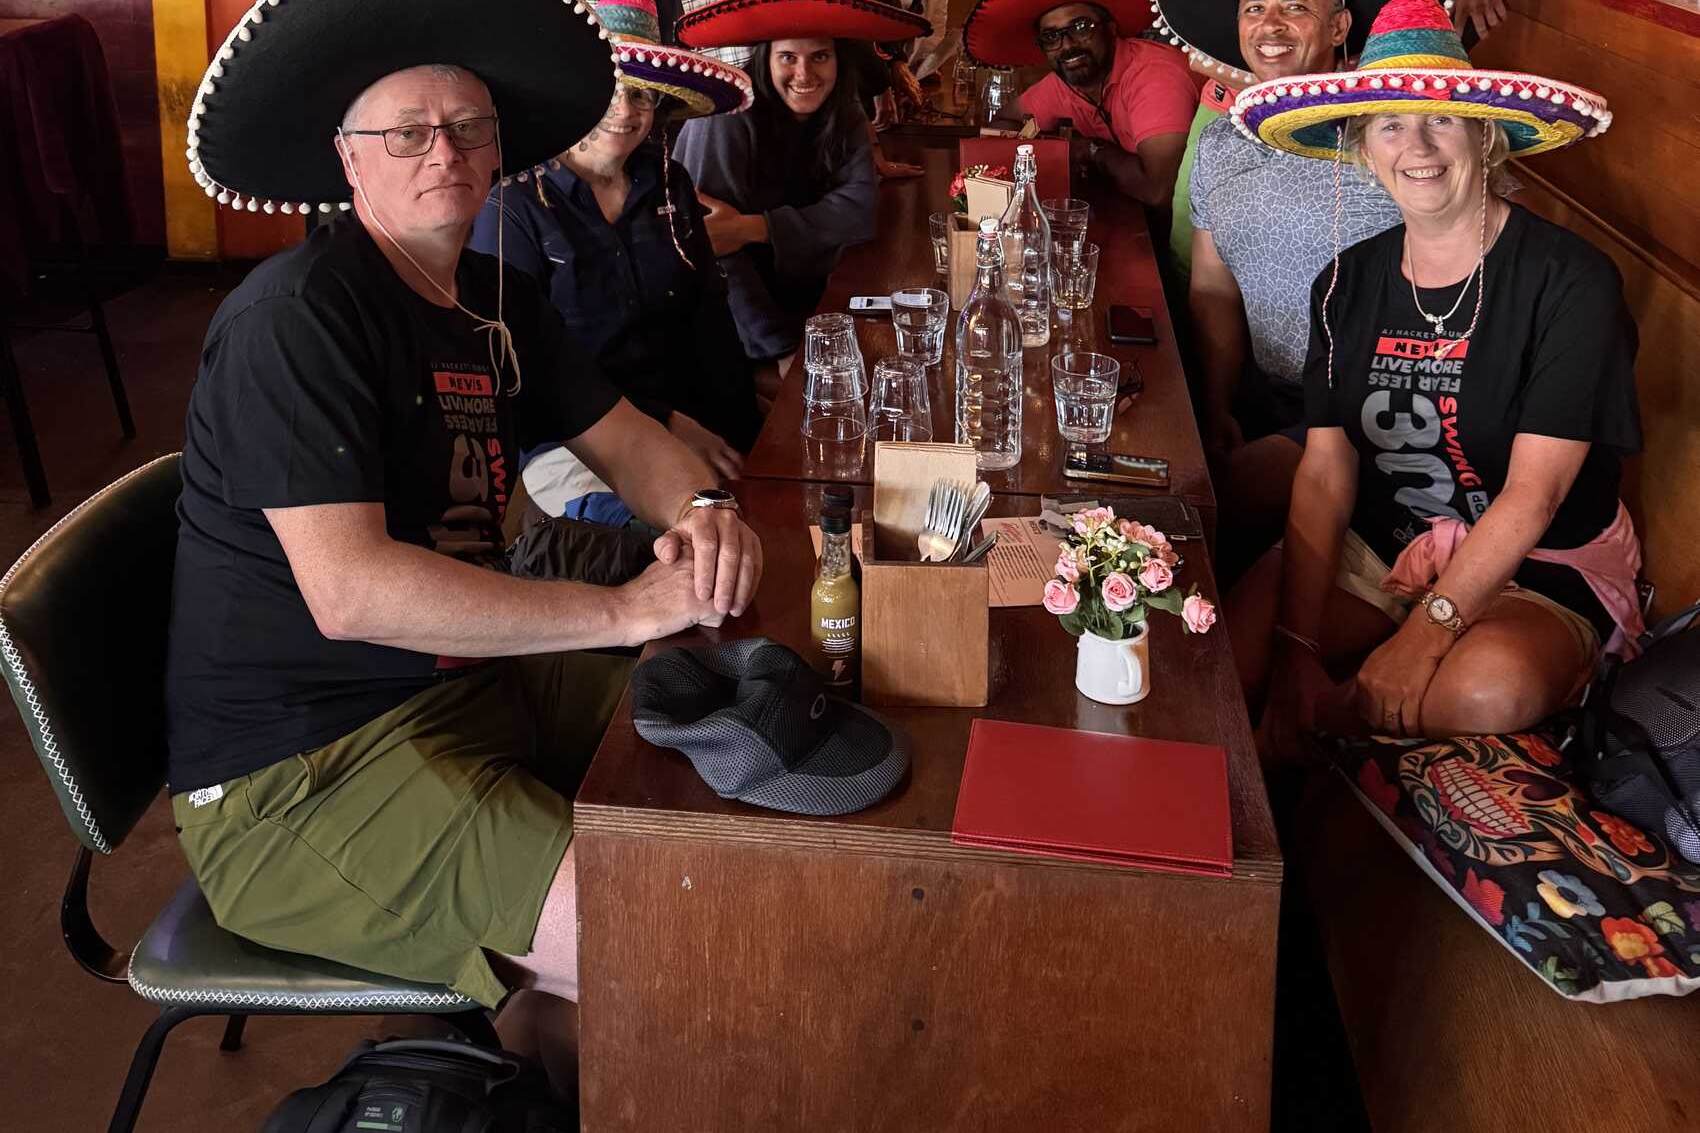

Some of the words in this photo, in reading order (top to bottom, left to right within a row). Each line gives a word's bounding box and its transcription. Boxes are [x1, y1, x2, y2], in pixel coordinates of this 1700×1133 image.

[1396, 329, 1441, 339] HACKET
[1371, 356, 1414, 374] LIVE
[1413, 357, 1464, 374] MORE
[1368, 372, 1412, 390] LESS
[1418, 375, 1462, 394] FEAR
[1438, 396, 1483, 488] SWING
[821, 616, 855, 630] MEXICO
